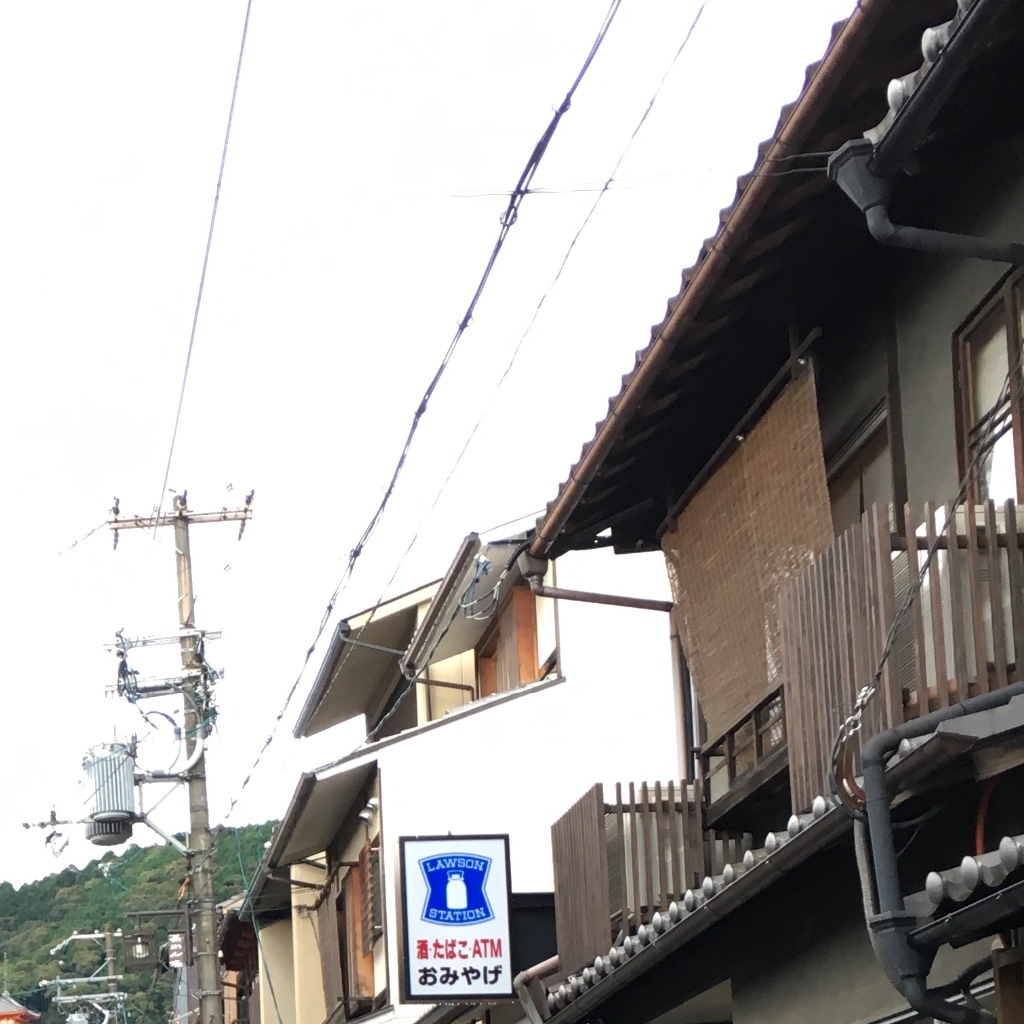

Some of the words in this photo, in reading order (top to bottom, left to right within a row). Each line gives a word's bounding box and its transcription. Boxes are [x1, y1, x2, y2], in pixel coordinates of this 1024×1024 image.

[426, 858, 485, 872] LAWSON
[429, 907, 487, 922] STATION
[418, 965, 503, 986] おみやげ
